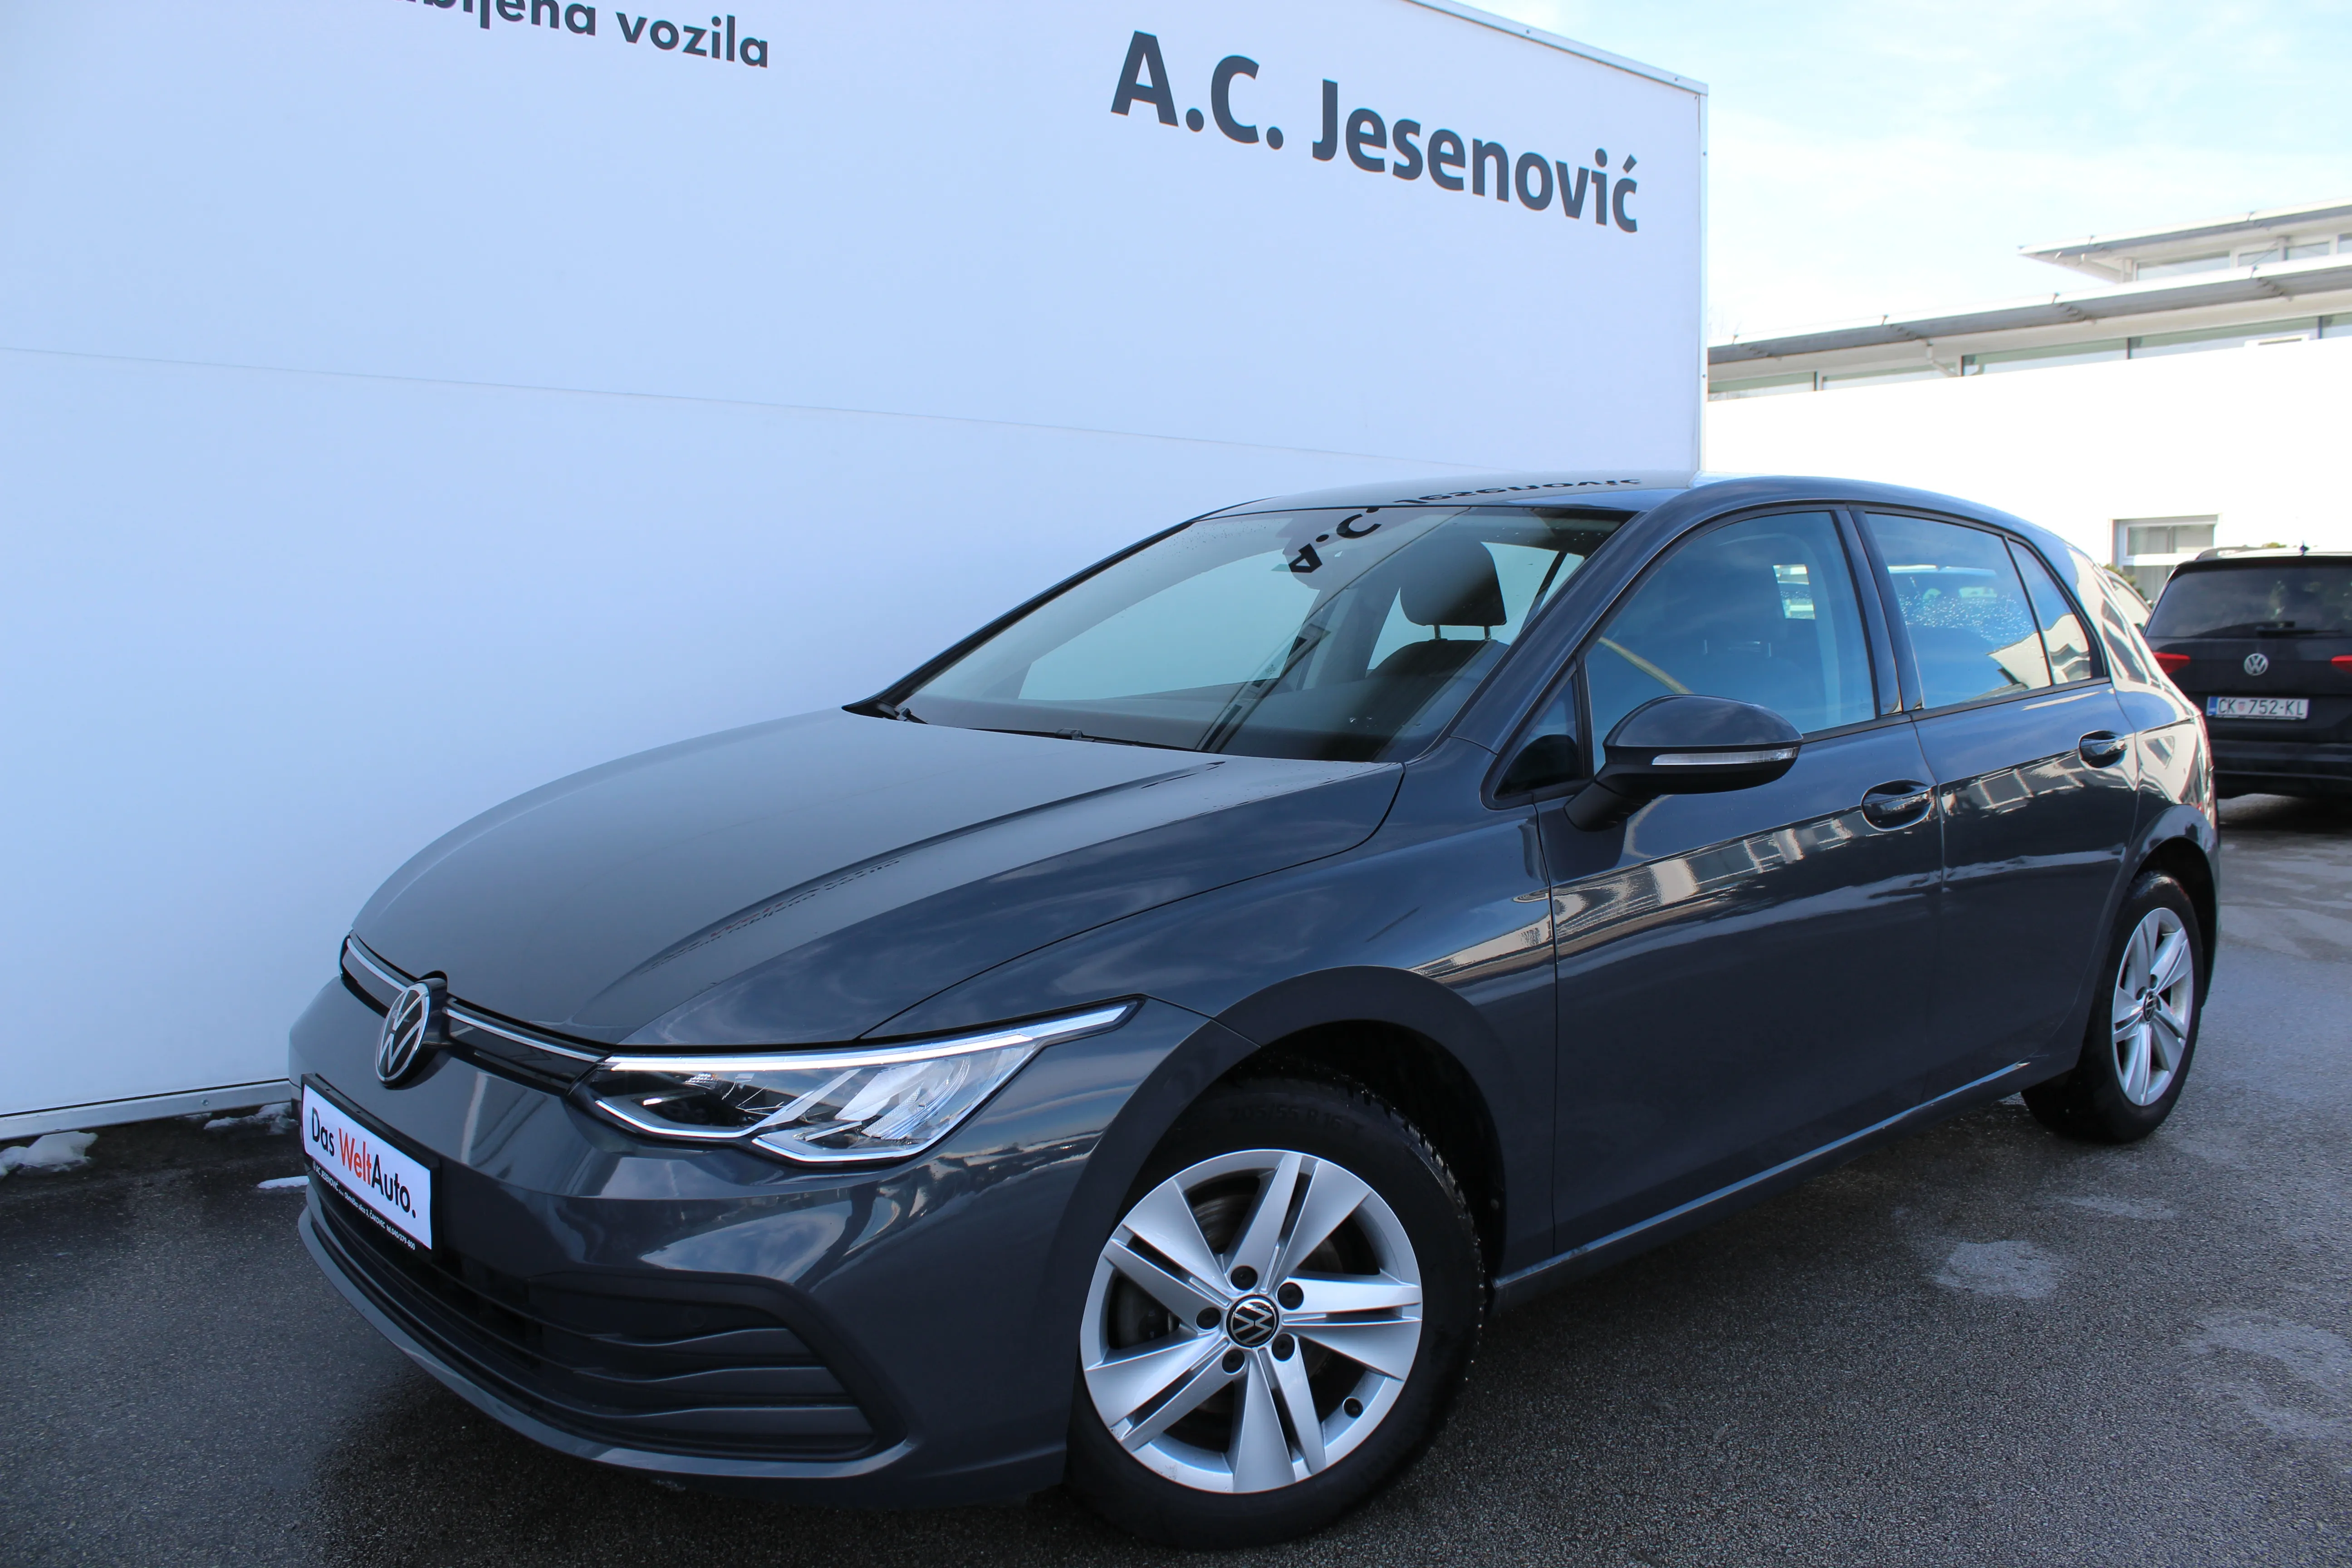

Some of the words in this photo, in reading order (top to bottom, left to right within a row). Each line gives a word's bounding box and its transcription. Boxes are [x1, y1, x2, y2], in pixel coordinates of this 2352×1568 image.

[615, 12, 768, 68] vozila
[1111, 30, 1284, 150] A.C.
[1312, 78, 1638, 233] Jesenović
[2219, 699, 2236, 714] CK
[2249, 699, 2304, 715] 752-KL
[311, 1107, 335, 1156] Das
[338, 1128, 416, 1219] WeltAuto.
